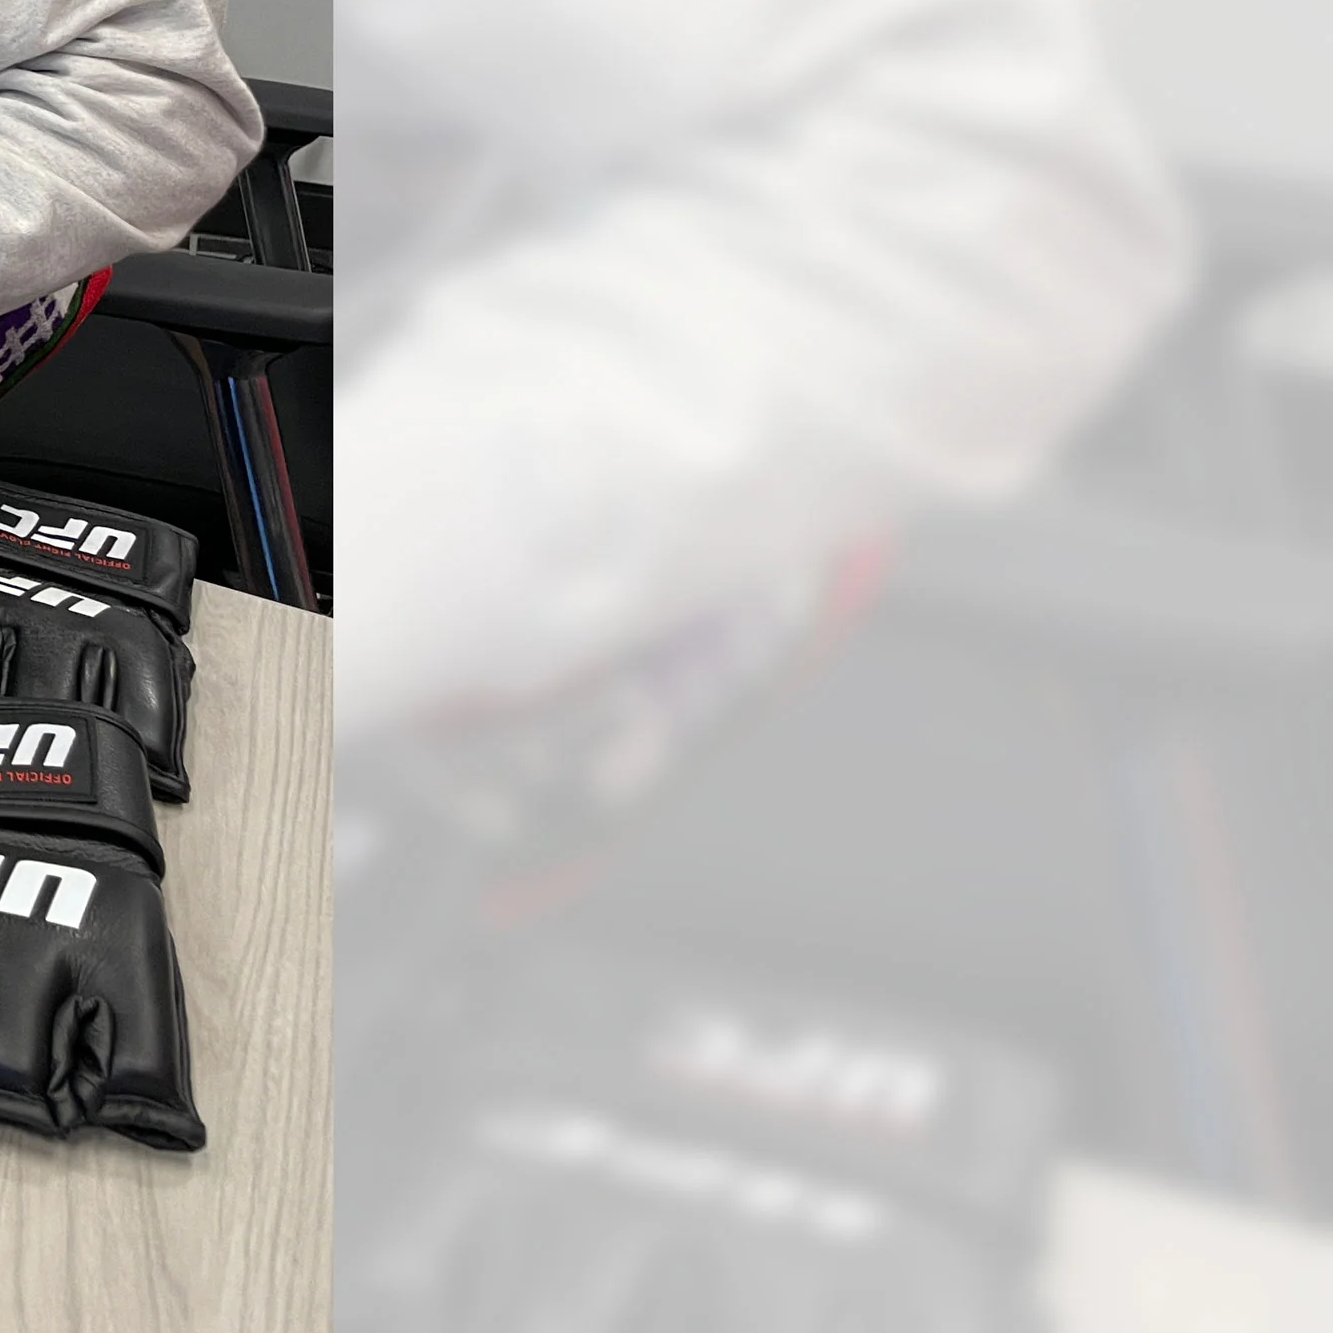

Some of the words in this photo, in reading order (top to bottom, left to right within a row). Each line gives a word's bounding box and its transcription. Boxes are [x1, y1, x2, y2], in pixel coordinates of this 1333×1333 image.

[35, 544, 70, 557] FIGHT
[76, 554, 130, 570] OFFICIAL
[7, 770, 73, 785] OFFICIAL
